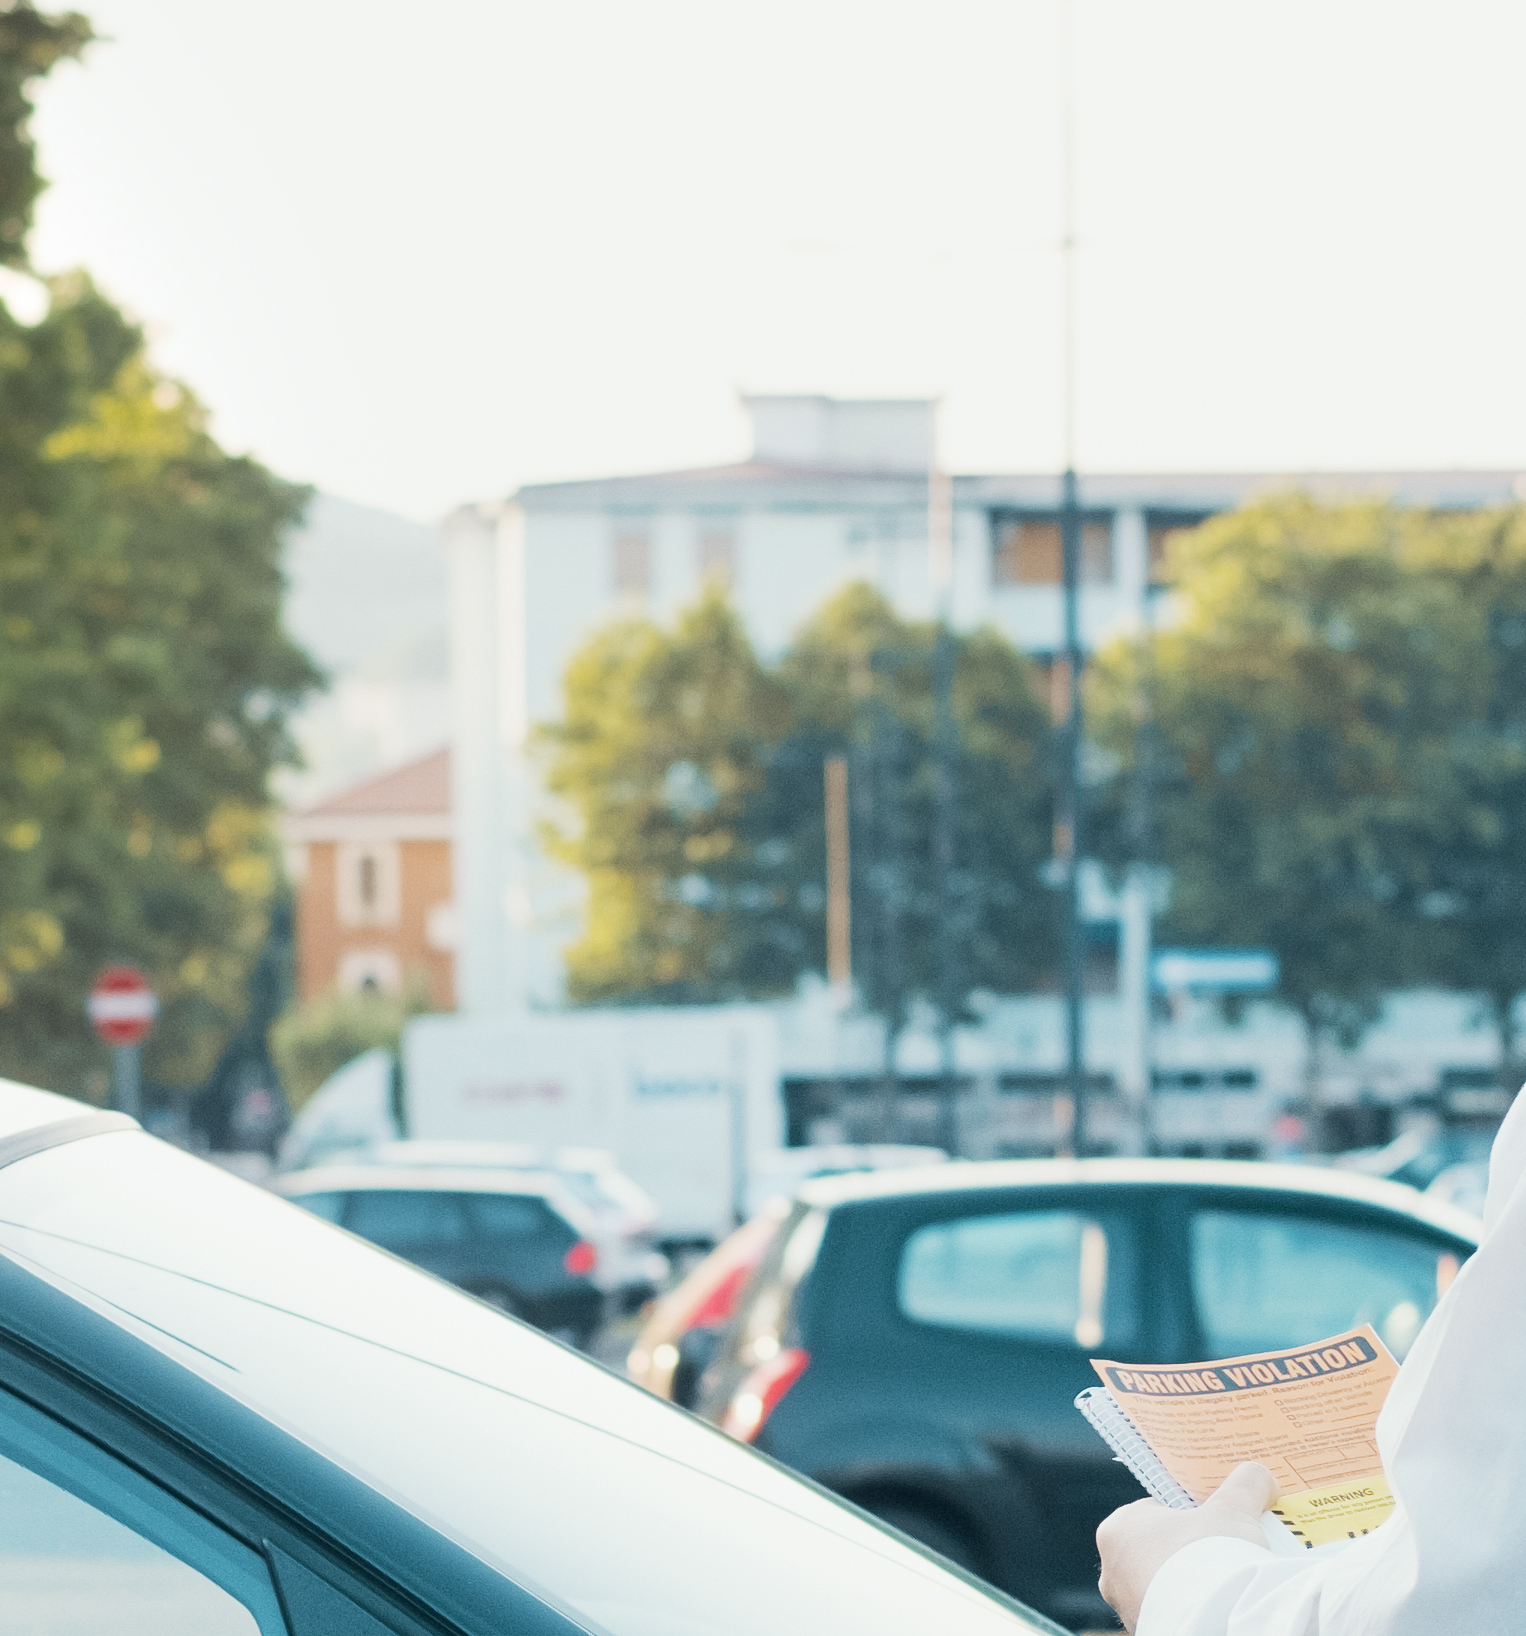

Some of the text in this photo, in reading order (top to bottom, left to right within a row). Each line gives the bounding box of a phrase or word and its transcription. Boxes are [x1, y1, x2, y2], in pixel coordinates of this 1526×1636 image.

[1116, 1341, 1368, 1393] PARKING VIOLATION
[1309, 1487, 1374, 1507] WARNING
